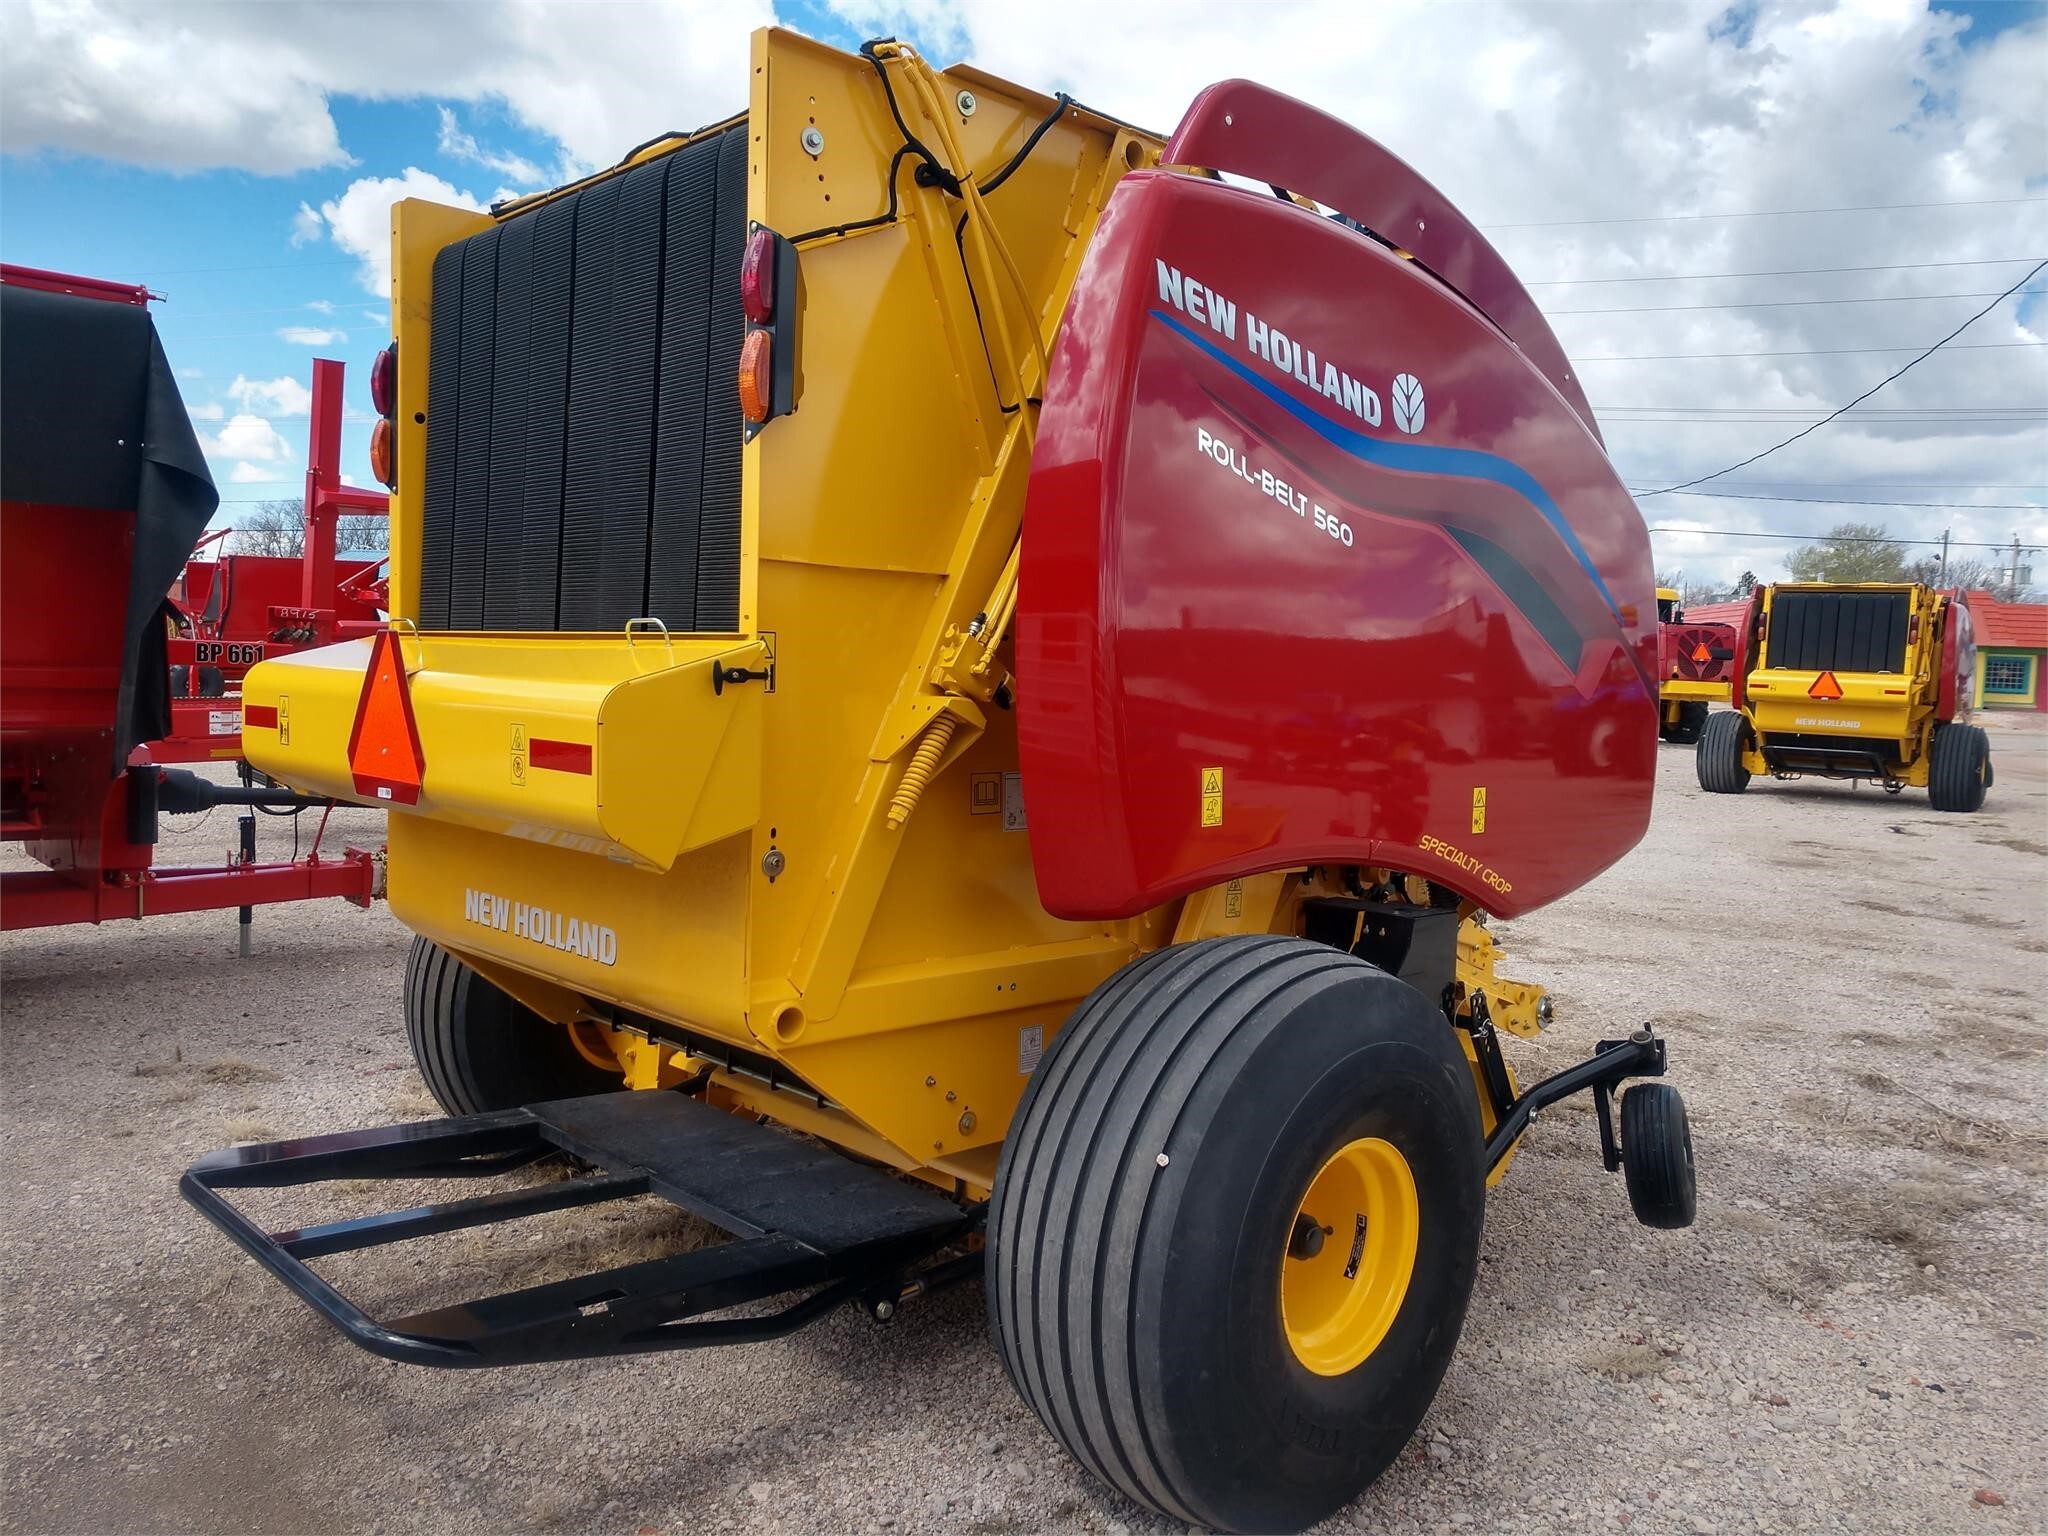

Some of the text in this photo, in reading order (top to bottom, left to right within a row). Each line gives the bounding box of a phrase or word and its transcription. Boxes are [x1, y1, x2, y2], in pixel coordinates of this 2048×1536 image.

[1155, 257, 1383, 429] NEW HOLLAND
[1198, 426, 1354, 547] ROLL-BELT 560
[195, 642, 264, 664] BP 661
[1795, 718, 1861, 728] NEW HOLLAND
[1418, 834, 1513, 894] SPECIALTY CROP
[465, 887, 618, 967] NEW HOLLAND
